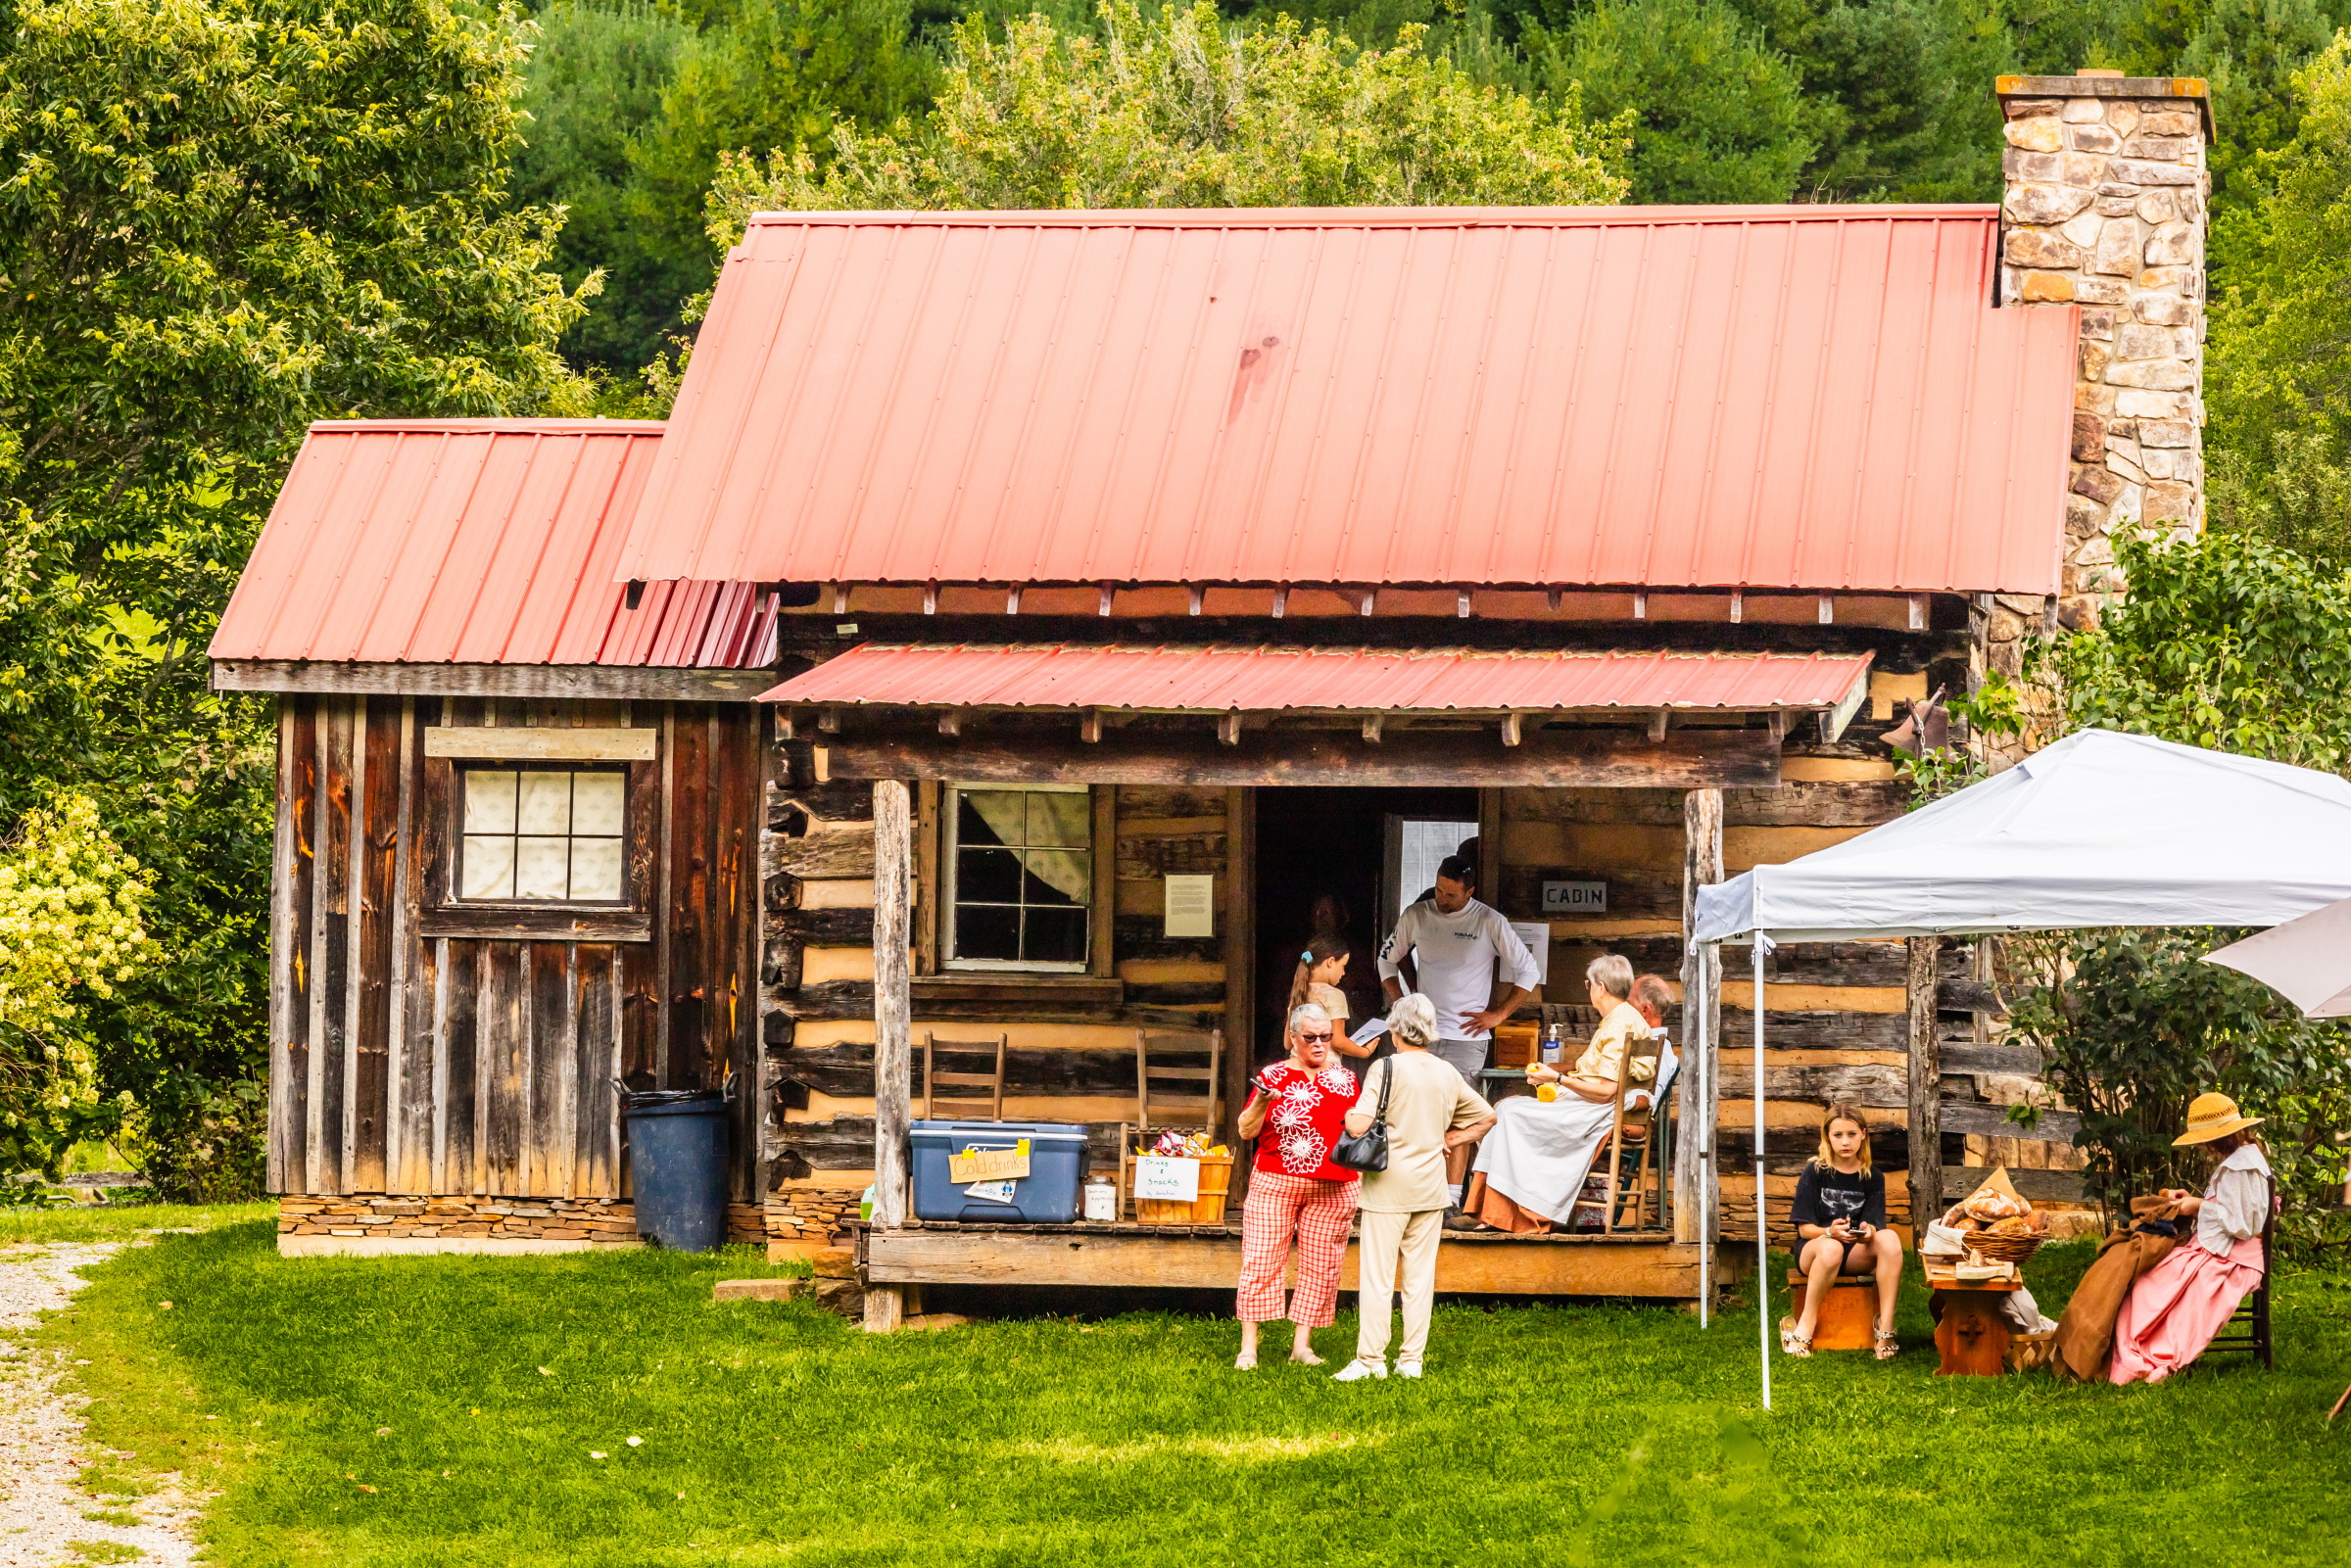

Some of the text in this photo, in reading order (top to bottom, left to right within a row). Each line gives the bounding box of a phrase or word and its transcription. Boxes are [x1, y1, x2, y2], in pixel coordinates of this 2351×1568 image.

[1547, 888, 1603, 904] CABIN
[954, 1154, 1028, 1176] Cold drinks
[1148, 1177, 1179, 1187] Snacks
